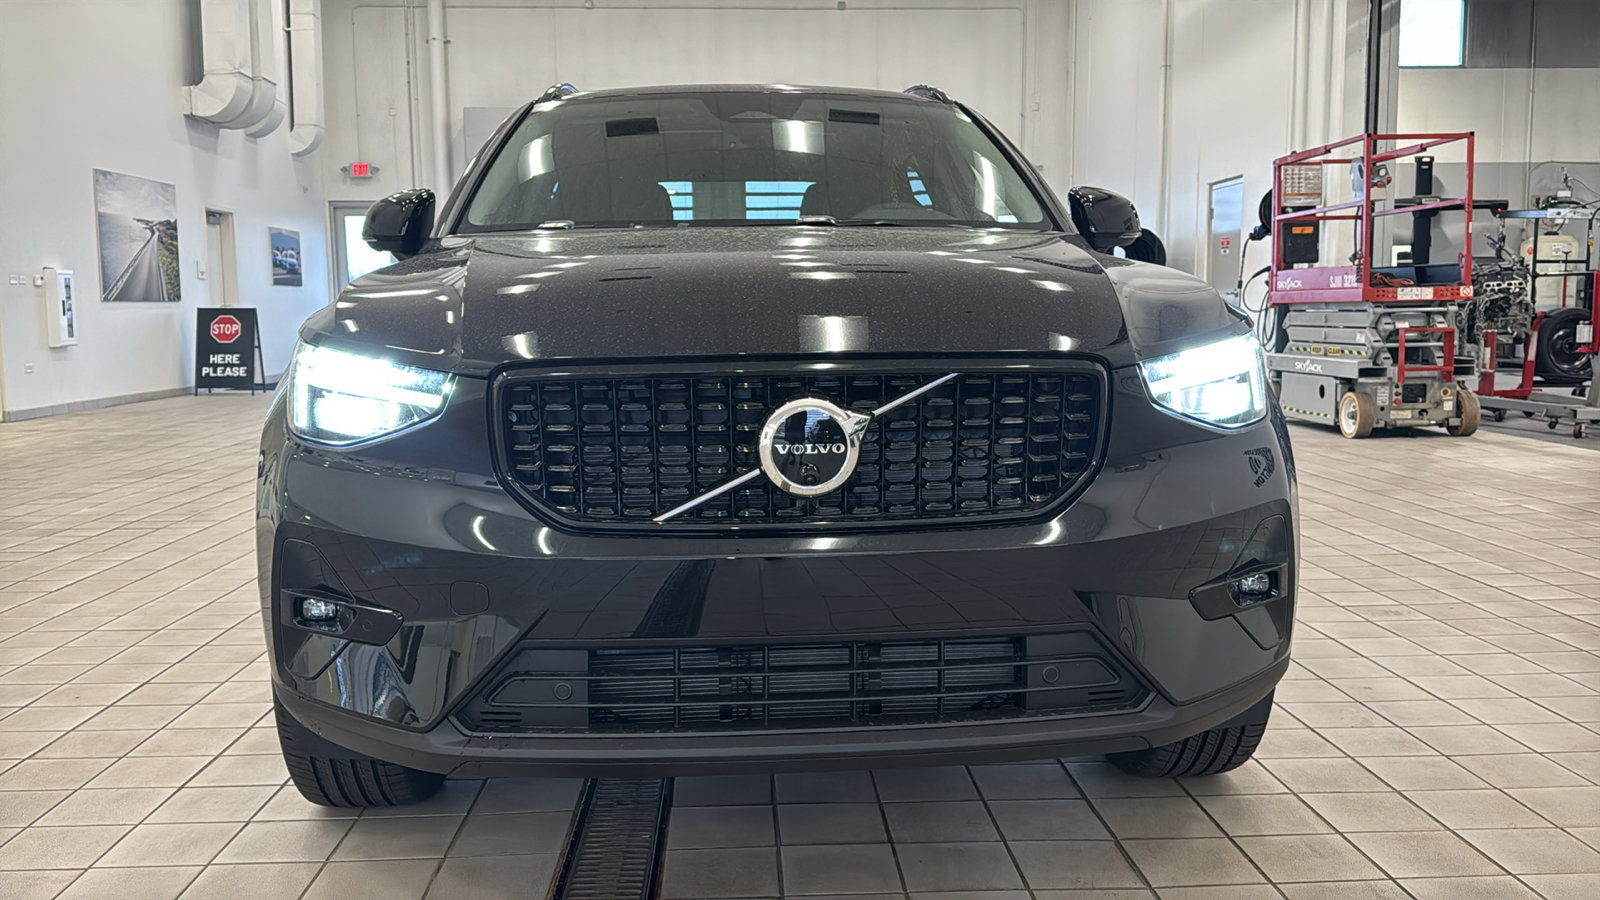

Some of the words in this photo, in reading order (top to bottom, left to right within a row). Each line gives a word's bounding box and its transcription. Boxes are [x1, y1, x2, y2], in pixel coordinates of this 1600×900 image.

[352, 163, 369, 176] EXIT
[1276, 277, 1303, 290] SKYJACK
[212, 323, 239, 335] STOP
[209, 354, 240, 364] HERE
[201, 366, 247, 377] PLEASE
[1295, 359, 1323, 373] SKYJACK
[774, 443, 846, 455] VOLVO
